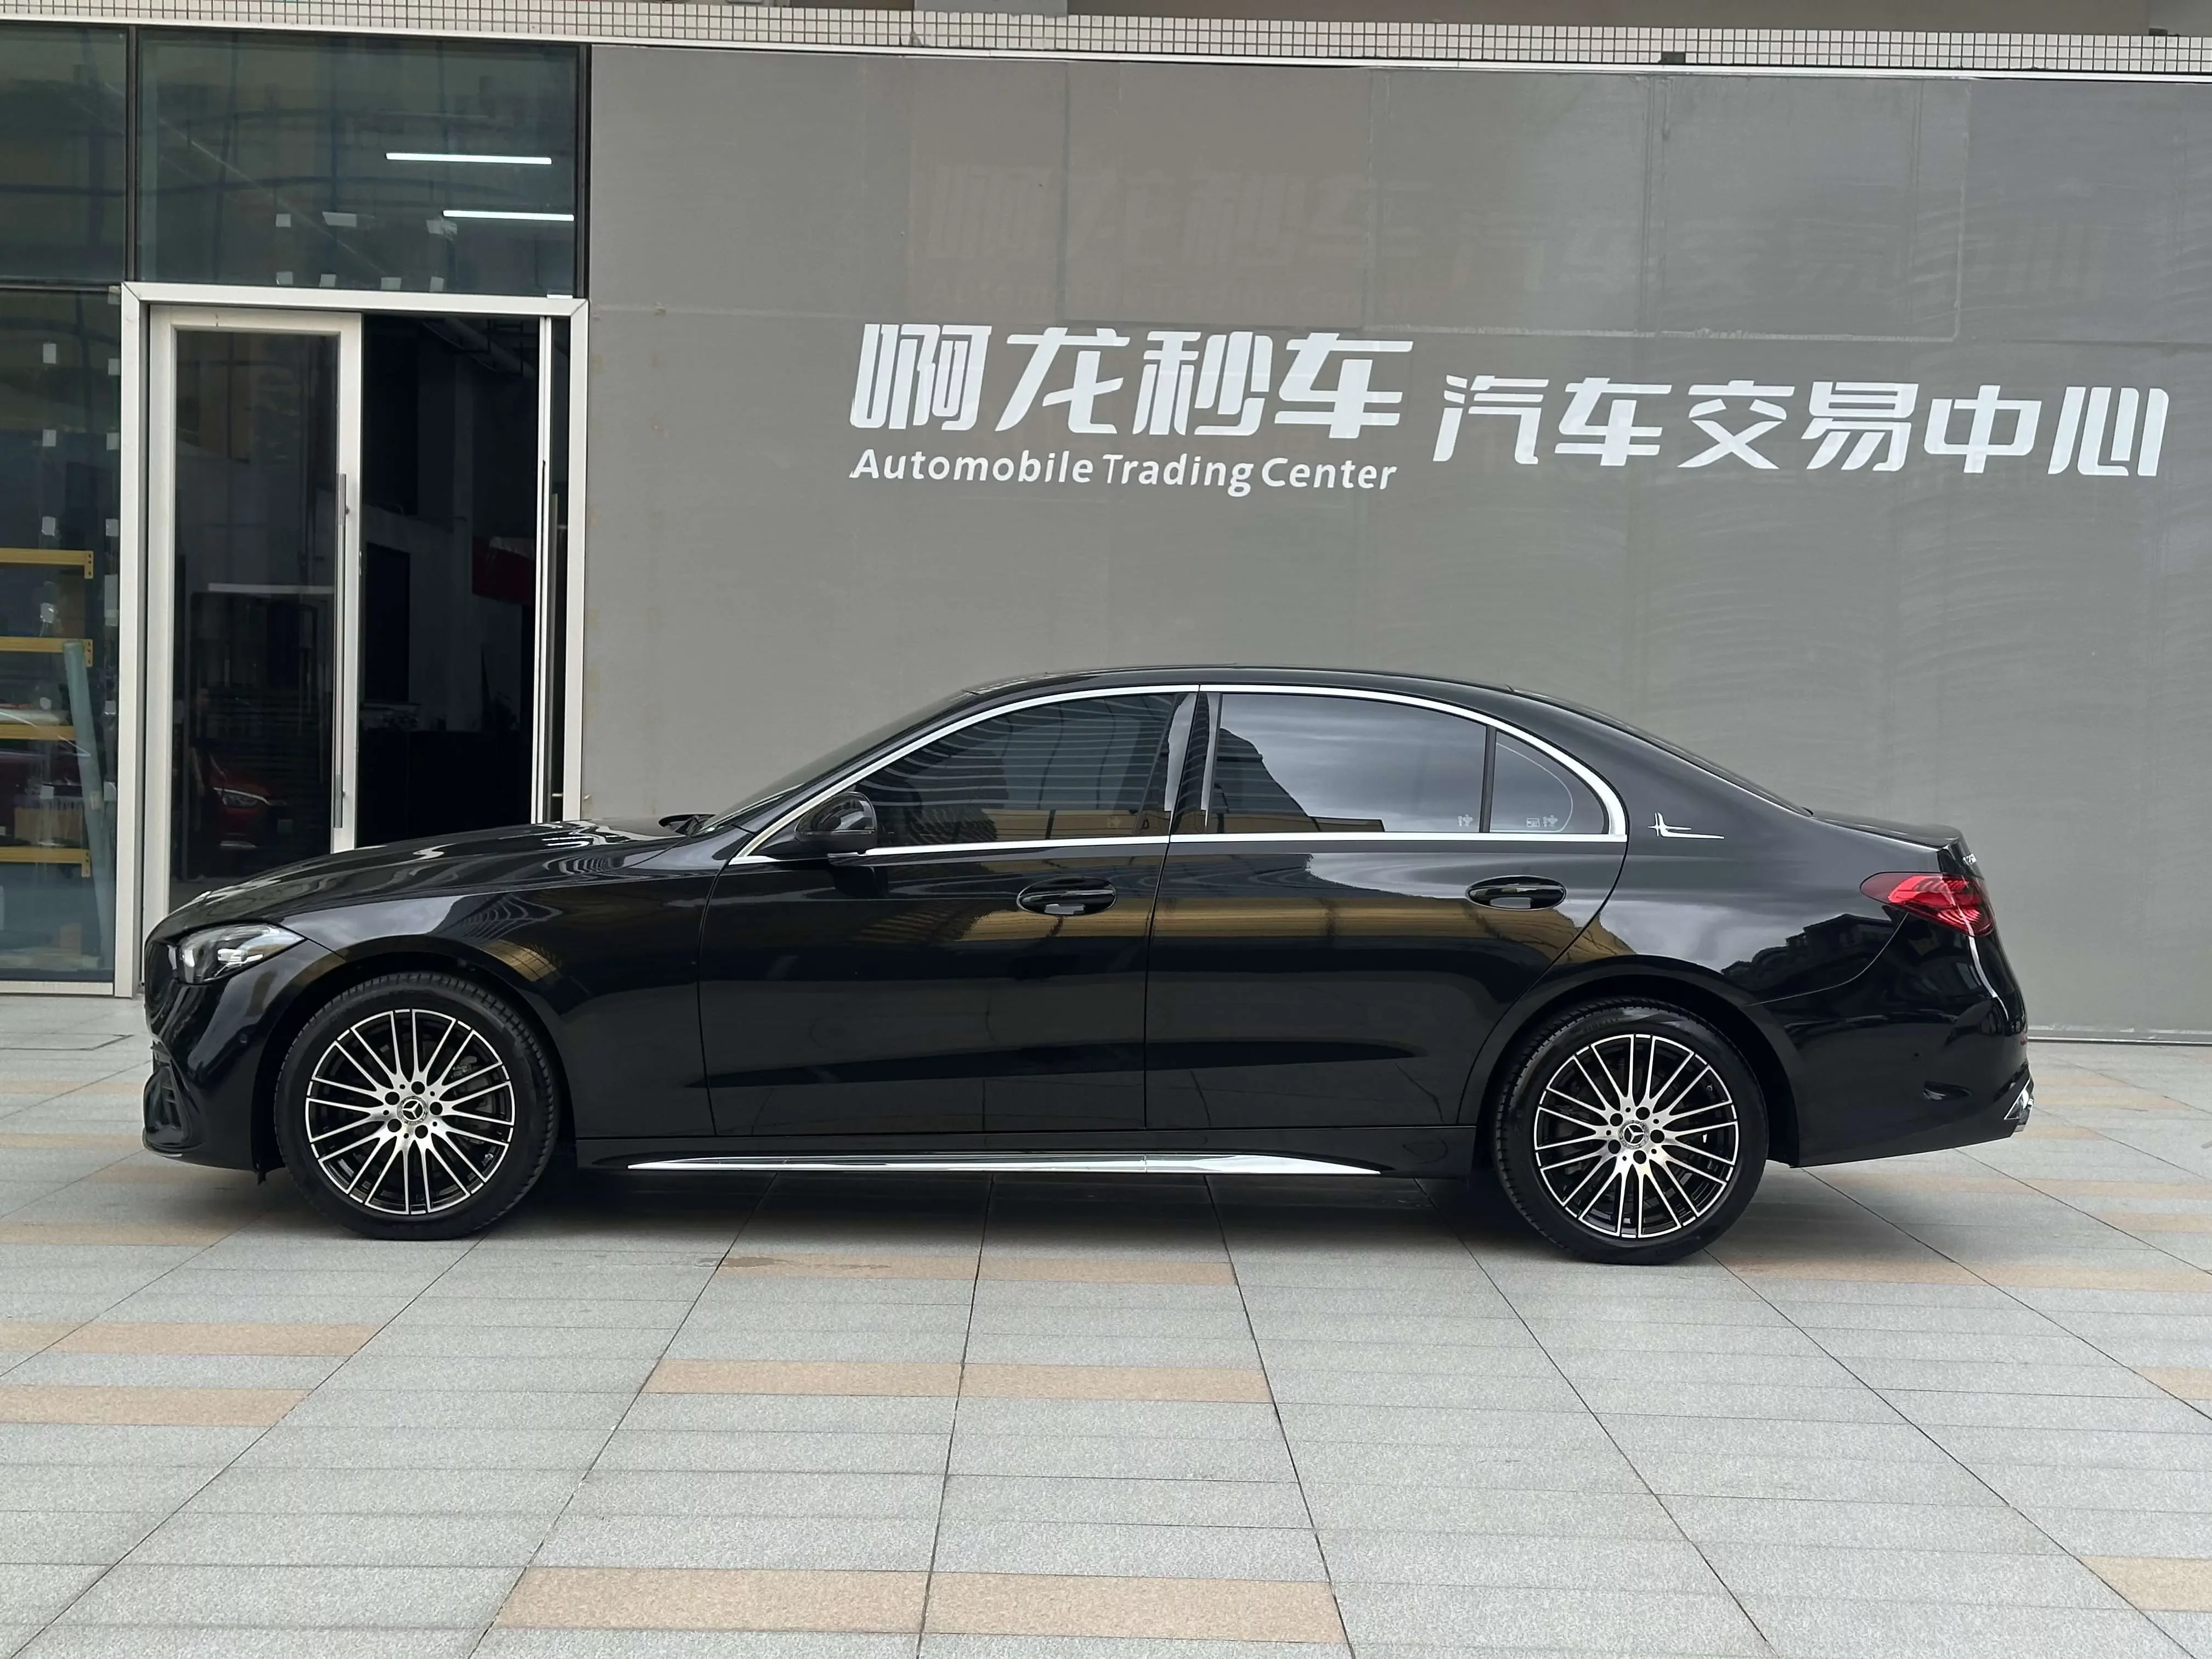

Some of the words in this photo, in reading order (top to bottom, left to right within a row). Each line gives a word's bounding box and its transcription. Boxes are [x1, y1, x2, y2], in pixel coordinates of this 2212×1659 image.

[850, 324, 1414, 439] 啊龙秒车
[1432, 375, 2169, 477] 汽车交易中心
[849, 449, 1093, 483] Automobile
[1102, 453, 1254, 497] Trading
[1262, 458, 1397, 490] Center
